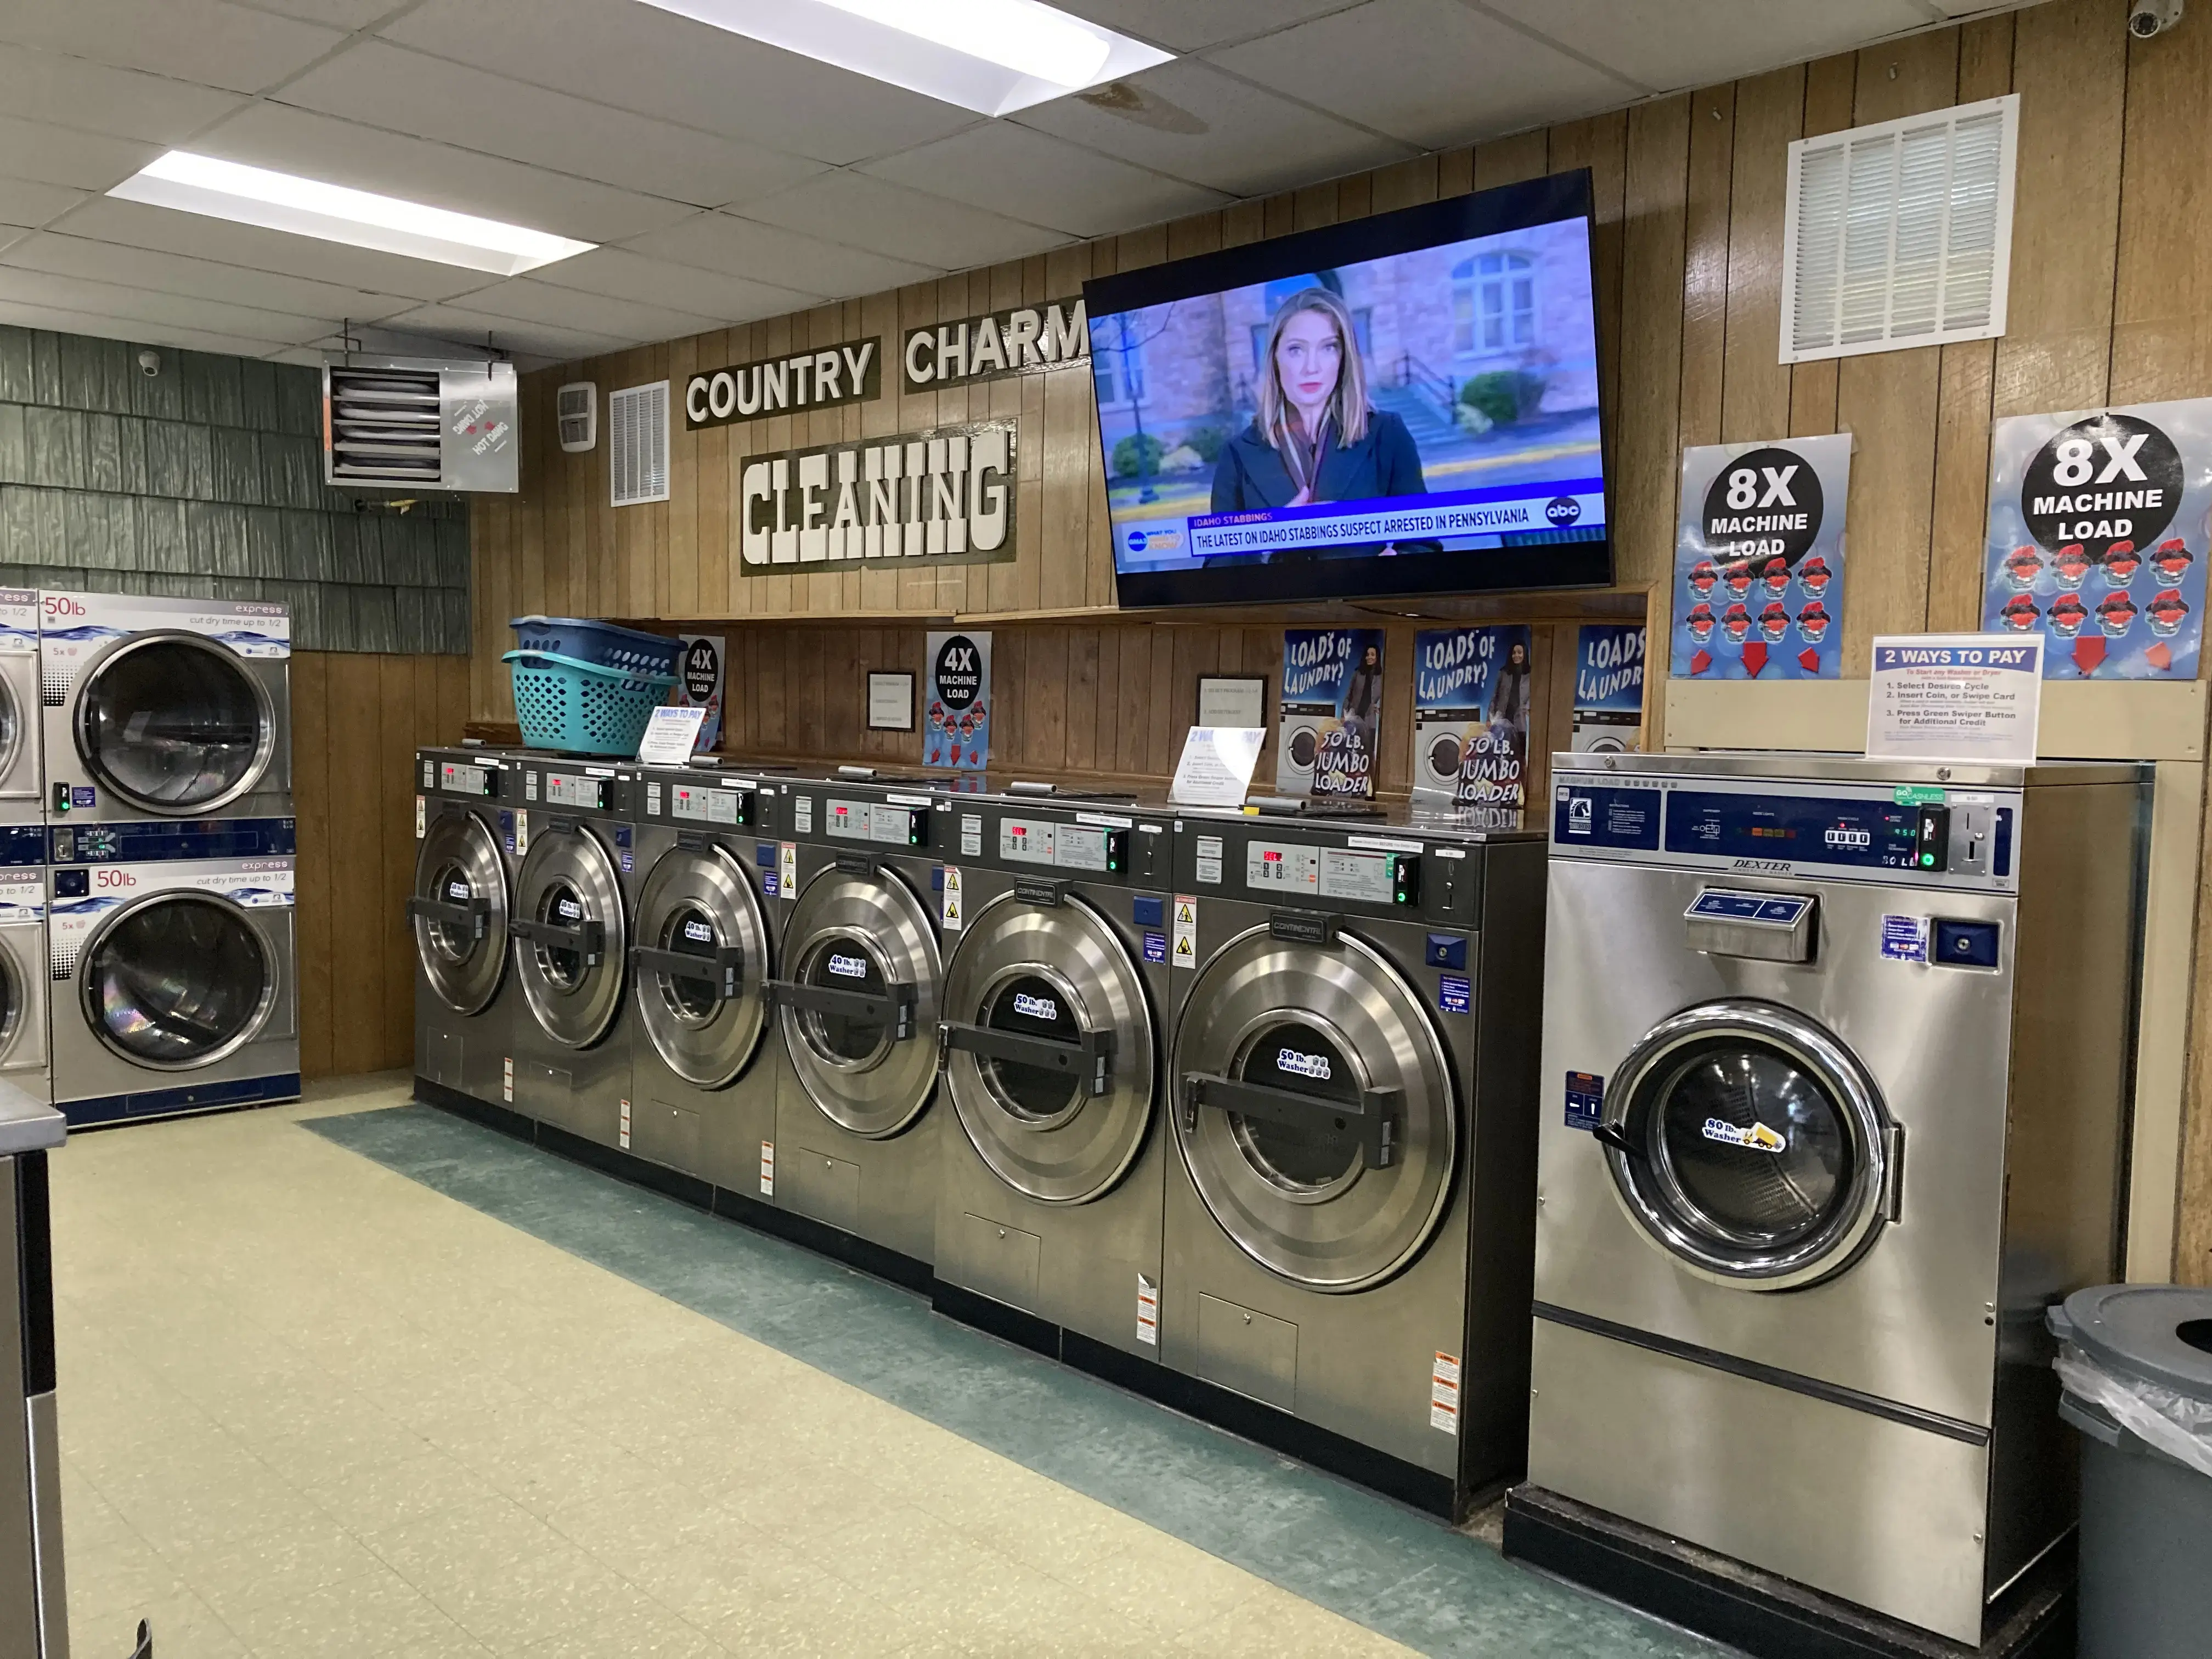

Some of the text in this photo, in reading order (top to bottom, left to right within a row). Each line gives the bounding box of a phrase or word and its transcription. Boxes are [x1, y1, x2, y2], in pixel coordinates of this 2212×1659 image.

[687, 300, 1090, 422] COUNTRY CHARM
[472, 422, 509, 455] HOT DAWG
[2053, 434, 2149, 487] 8X
[1726, 465, 1799, 510] 8X
[743, 430, 1010, 565] CLEANING
[2033, 489, 2163, 515] MACHINE
[1547, 503, 1579, 517] abc
[1194, 512, 1273, 527] IDAHO STABBINGS
[1197, 507, 1530, 548] THE LATEST ON IDAHO STABBINGS SUSPECT ARRESTED IN PENNSYLVANIA
[1711, 514, 1808, 534] MACHINE
[2058, 519, 2133, 540] LOAD
[1729, 539, 1785, 557] LOAD
[45, 597, 86, 616] 50lb
[235, 605, 283, 614] express
[206, 617, 220, 627] dry
[244, 619, 255, 628] up
[1291, 631, 1352, 668] LOADS OF
[1426, 630, 1495, 670] LOADS OF
[1588, 627, 1646, 668] LOADS
[691, 648, 712, 670] 4X
[945, 647, 973, 672] 4X
[1885, 650, 2027, 664] 2 WAYS TO PAY
[687, 672, 715, 682] MACHINE
[939, 675, 977, 685] MACHINE
[1284, 663, 1344, 696] LAUNDRY?
[1419, 663, 1488, 701] LAUNDRY?
[1578, 666, 1643, 701] LAUNDR
[692, 684, 709, 693] LOAD
[947, 689, 969, 698] LOAD
[1964, 682, 1989, 691] Cycle
[661, 708, 679, 718] WAYS
[680, 709, 689, 718] TO
[689, 710, 702, 719] PAY
[1952, 710, 1982, 718] Swiper
[1321, 731, 1364, 751] 50 LB.
[1466, 737, 1514, 755] 50 LB.
[1317, 752, 1369, 773] JUMBO
[1461, 759, 1520, 781] JUMBO
[1315, 773, 1368, 793] LOADER
[1458, 781, 1519, 802] LOADER
[242, 861, 288, 871] express
[1734, 859, 1791, 871] DEXTER
[98, 870, 136, 887] 50lb
[213, 877, 226, 886] dry
[20, 885, 35, 894] 1/2
[830, 965, 854, 974] Washer
[1017, 995, 1027, 1003] 50
[1015, 1004, 1039, 1014] Washer
[1281, 1051, 1306, 1063] 50 lb.
[1279, 1060, 1308, 1073] Washer
[1705, 1129, 1741, 1142] Washer
[1708, 1120, 1736, 1133] 80 lb.
